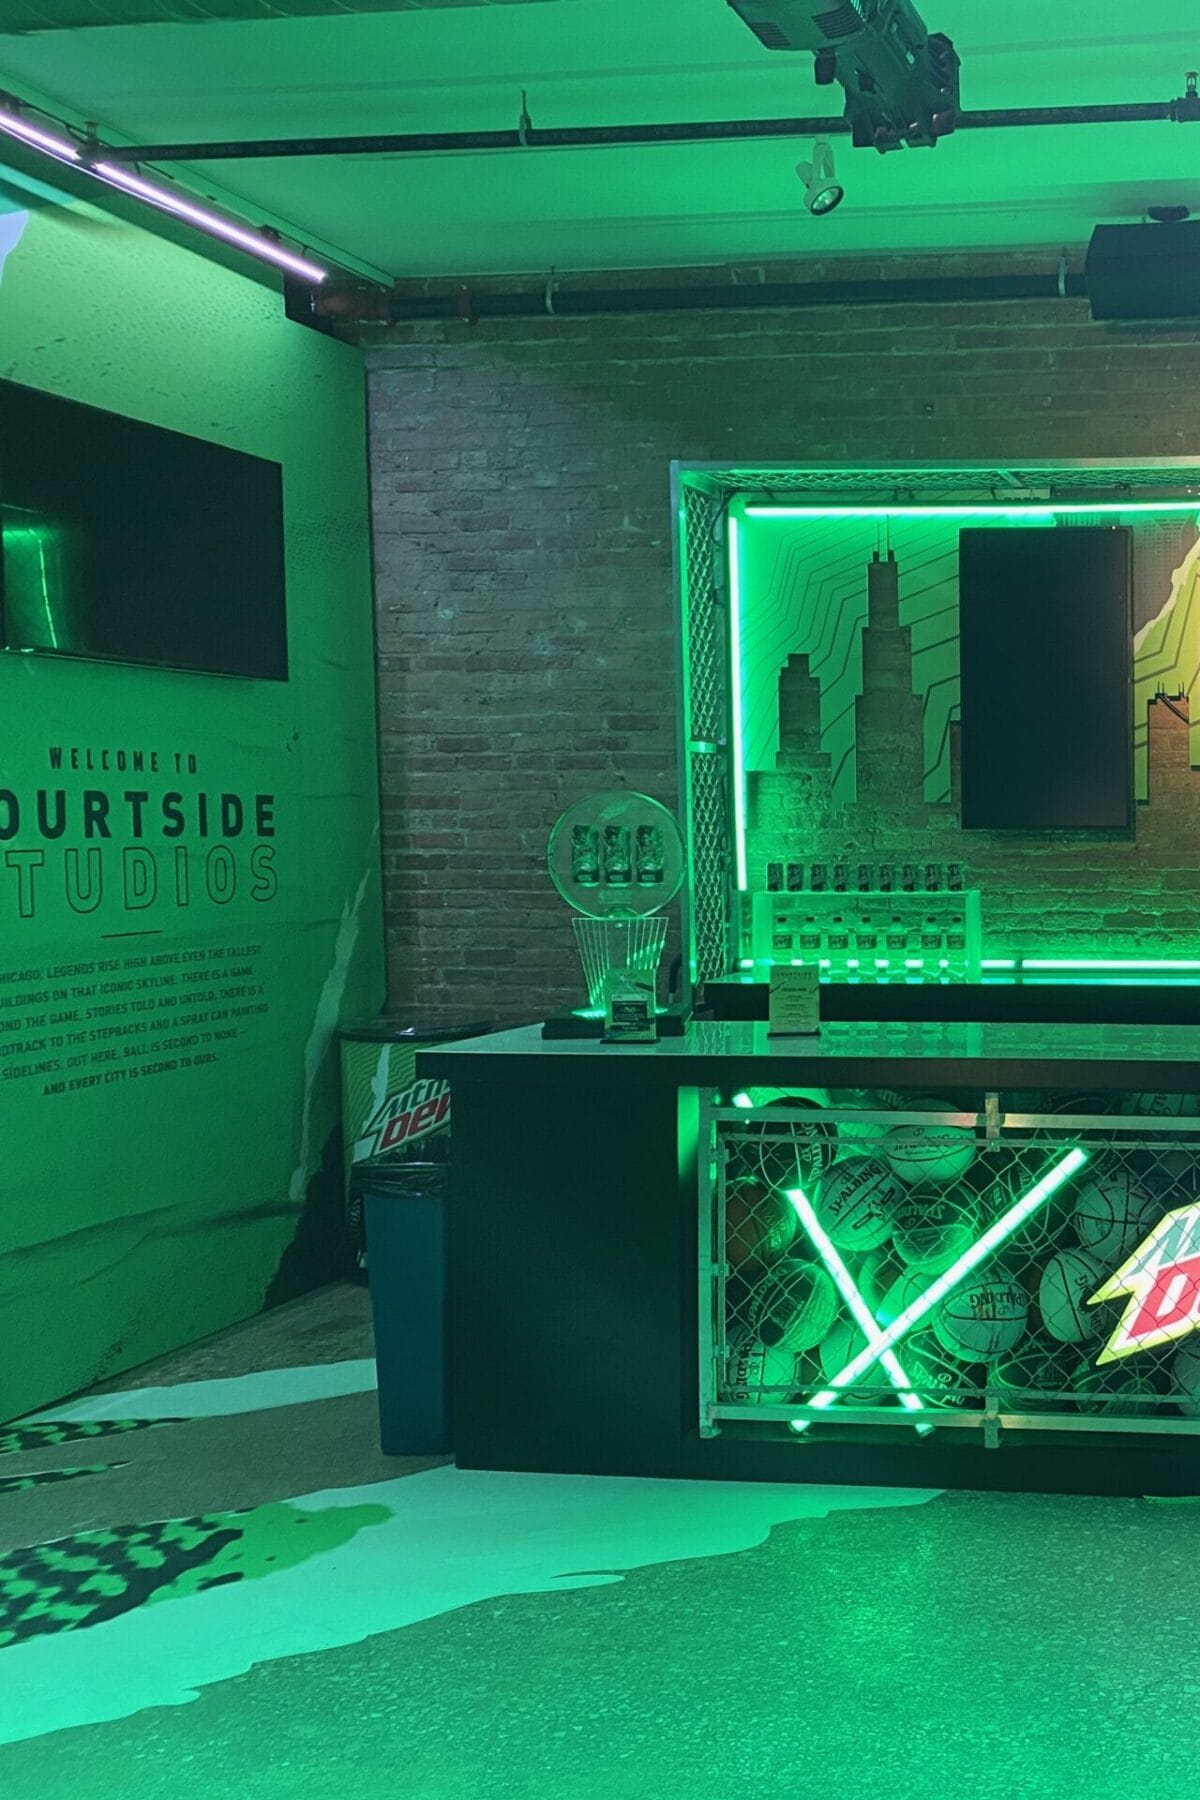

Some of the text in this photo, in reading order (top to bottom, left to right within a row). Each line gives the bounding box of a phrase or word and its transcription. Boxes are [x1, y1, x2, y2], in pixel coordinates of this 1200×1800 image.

[49, 747, 197, 774] WELCOME TO
[0, 788, 275, 841] OURTSIDE
[5, 844, 279, 917] TUDIOS
[47, 963, 95, 979] LEGENDS
[98, 960, 120, 972] RISE
[124, 957, 147, 969] HIGH
[150, 953, 181, 966] ABOVE
[183, 950, 205, 963] EVEN
[208, 949, 224, 959] THE
[53, 989, 67, 1001] ON
[71, 984, 96, 998] THAT
[100, 980, 134, 995] ICONIC
[181, 970, 209, 983] THERE
[212, 969, 221, 980] IS
[230, 966, 253, 976] GAME
[25, 1015, 46, 1028] THE
[86, 1003, 127, 1019] STORIES
[130, 999, 155, 1012] TOLD
[158, 996, 177, 1008] AND
[219, 986, 245, 998] THERE
[248, 985, 256, 996] IS
[0, 1038, 46, 1057] DTRACK
[50, 1036, 64, 1047] TO
[66, 1032, 87, 1045] THE
[89, 1022, 147, 1041] STEPBACKS
[150, 1019, 170, 1031] AND
[180, 1012, 209, 1026] SPRAY
[211, 1010, 228, 1021] CAN
[67, 1054, 88, 1068] OUT
[123, 1044, 149, 1058] BALL
[151, 1041, 160, 1053] IS
[162, 1035, 199, 1051] SECOND
[200, 1032, 212, 1043] TO
[42, 1081, 66, 1096] AND
[69, 1074, 102, 1091] EVERY
[104, 1069, 127, 1084] CITY
[129, 1067, 139, 1079] IS
[141, 1059, 177, 1077] SECOND
[180, 1056, 192, 1068] TO
[829, 1163, 883, 1216] SPALDING
